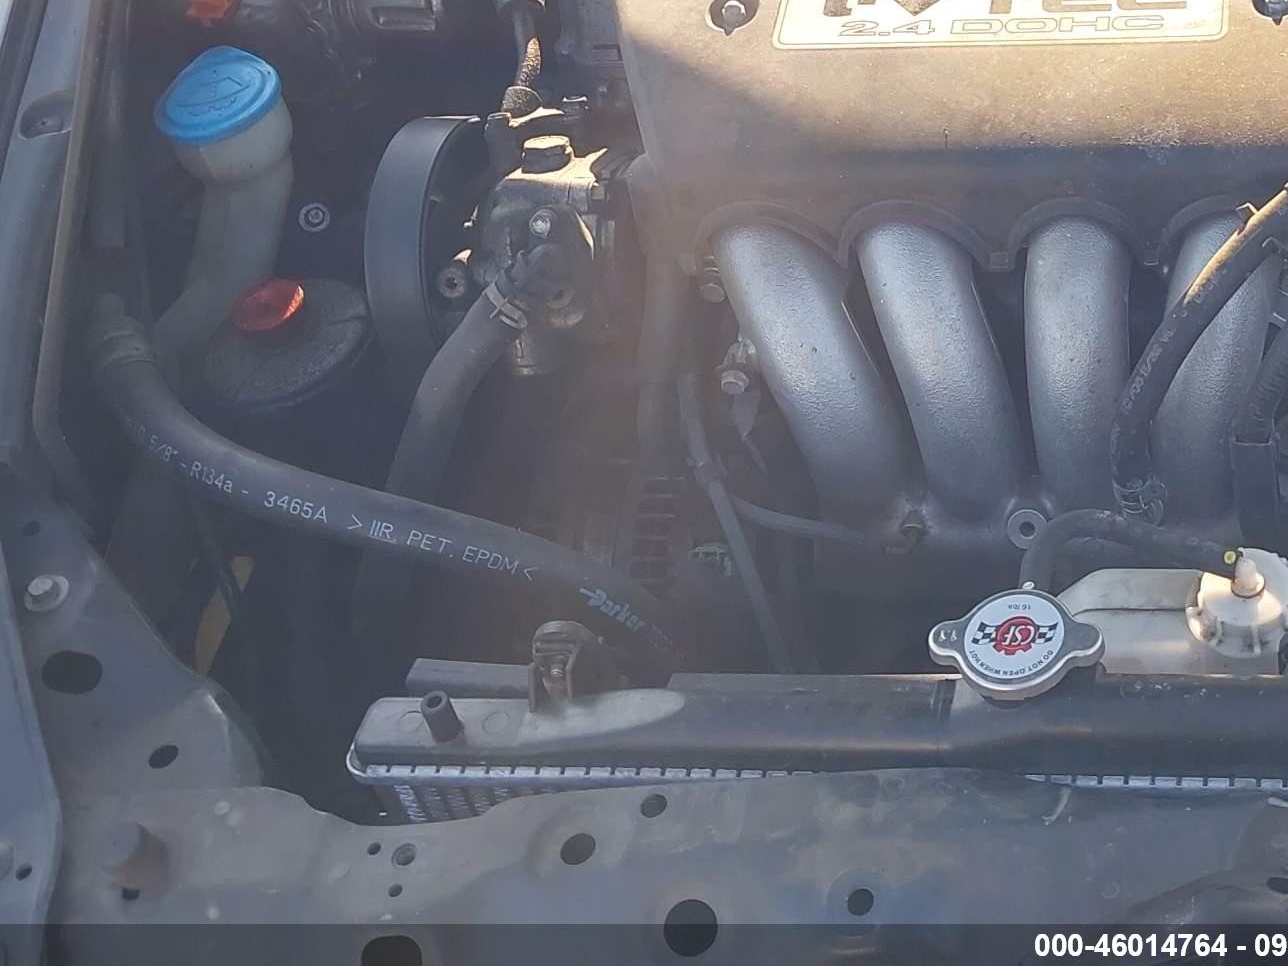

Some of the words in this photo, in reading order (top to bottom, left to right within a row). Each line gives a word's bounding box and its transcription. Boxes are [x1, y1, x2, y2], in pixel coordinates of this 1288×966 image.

[839, 19, 936, 37] 2.4
[950, 15, 1165, 36] DOHC
[190, 460, 233, 494] R134a
[263, 490, 328, 523] 3465A
[1002, 624, 1035, 646] CSF
[968, 649, 981, 664] HOT
[1043, 649, 1054, 662] DO
[979, 661, 1001, 676] WHEN
[1002, 667, 1026, 676] OPEN
[1026, 659, 1045, 672] NOT
